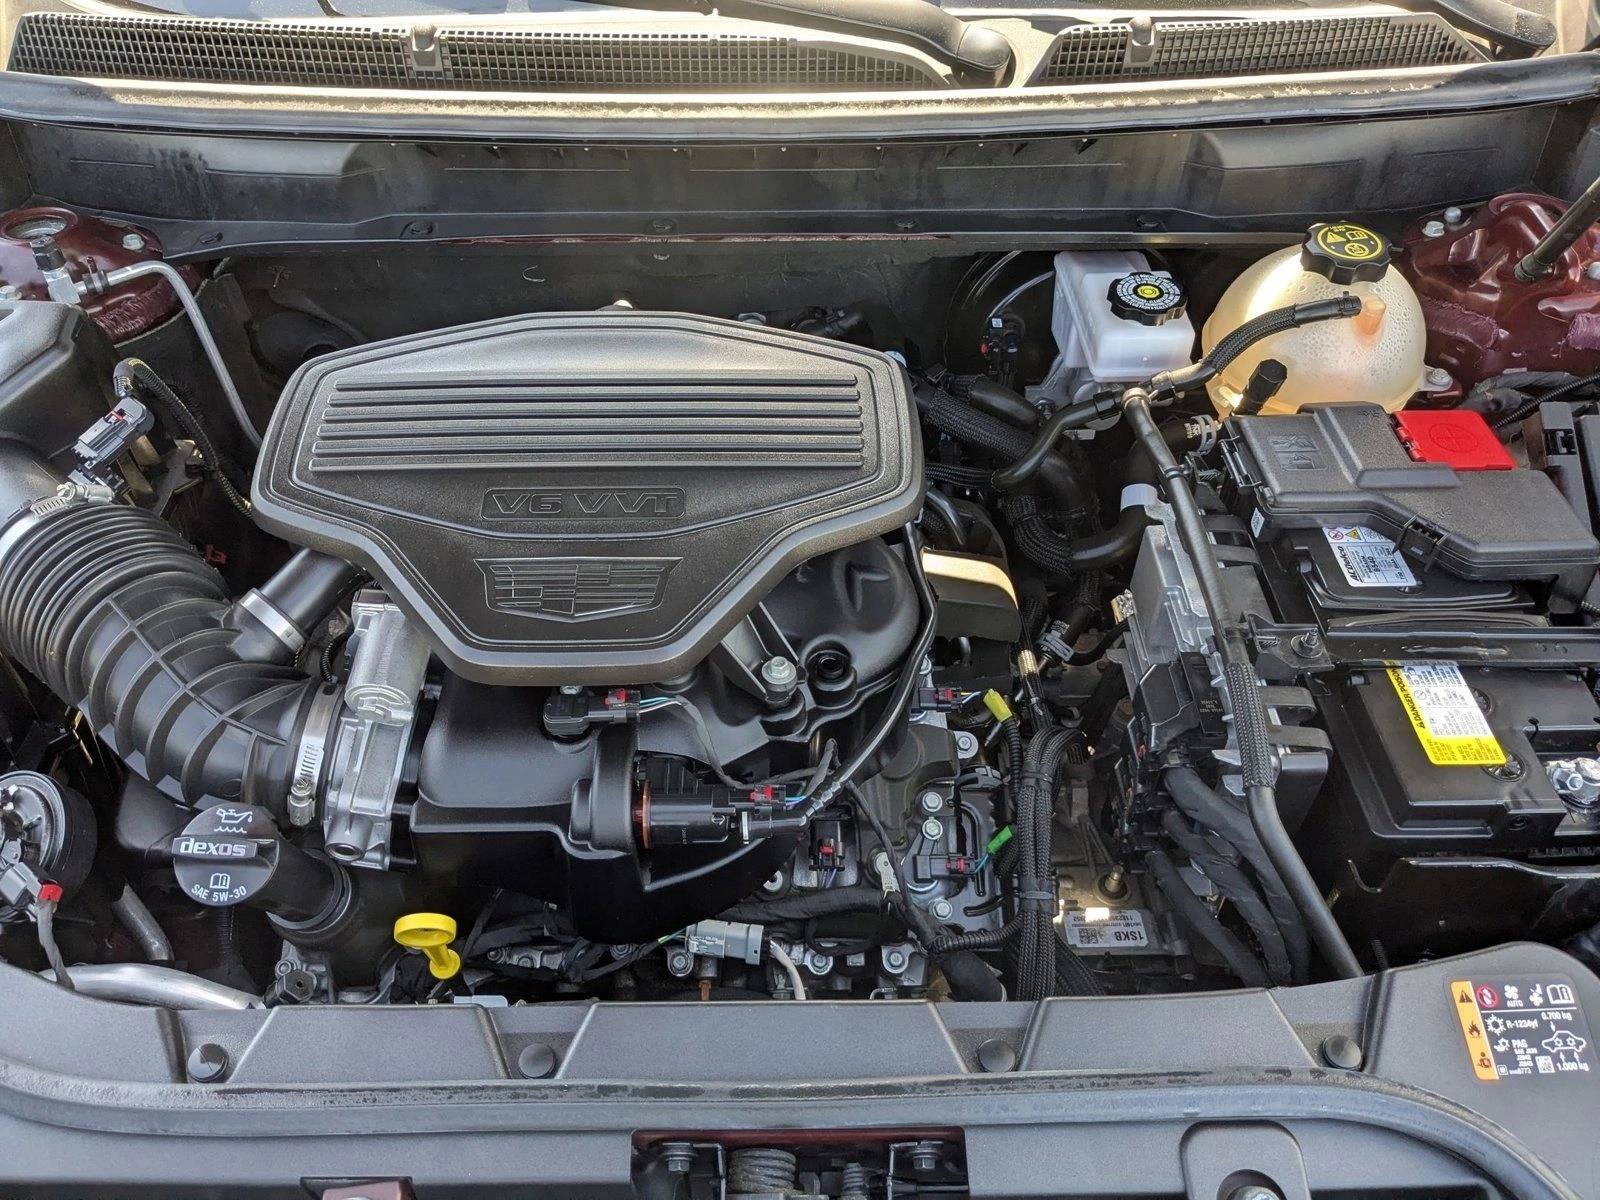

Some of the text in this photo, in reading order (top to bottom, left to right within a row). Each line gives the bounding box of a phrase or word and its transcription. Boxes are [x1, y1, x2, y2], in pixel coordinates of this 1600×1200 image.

[492, 492, 677, 514] V6 VVT
[1337, 545, 1360, 581] ACDelco
[1391, 668, 1421, 722] DANGER POISON
[180, 838, 246, 857] dexos
[191, 884, 247, 902] SAE 5W-30
[1114, 930, 1144, 941] 1SKB
[1507, 1000, 1524, 1008] AUTO
[1562, 1011, 1573, 1021] kg
